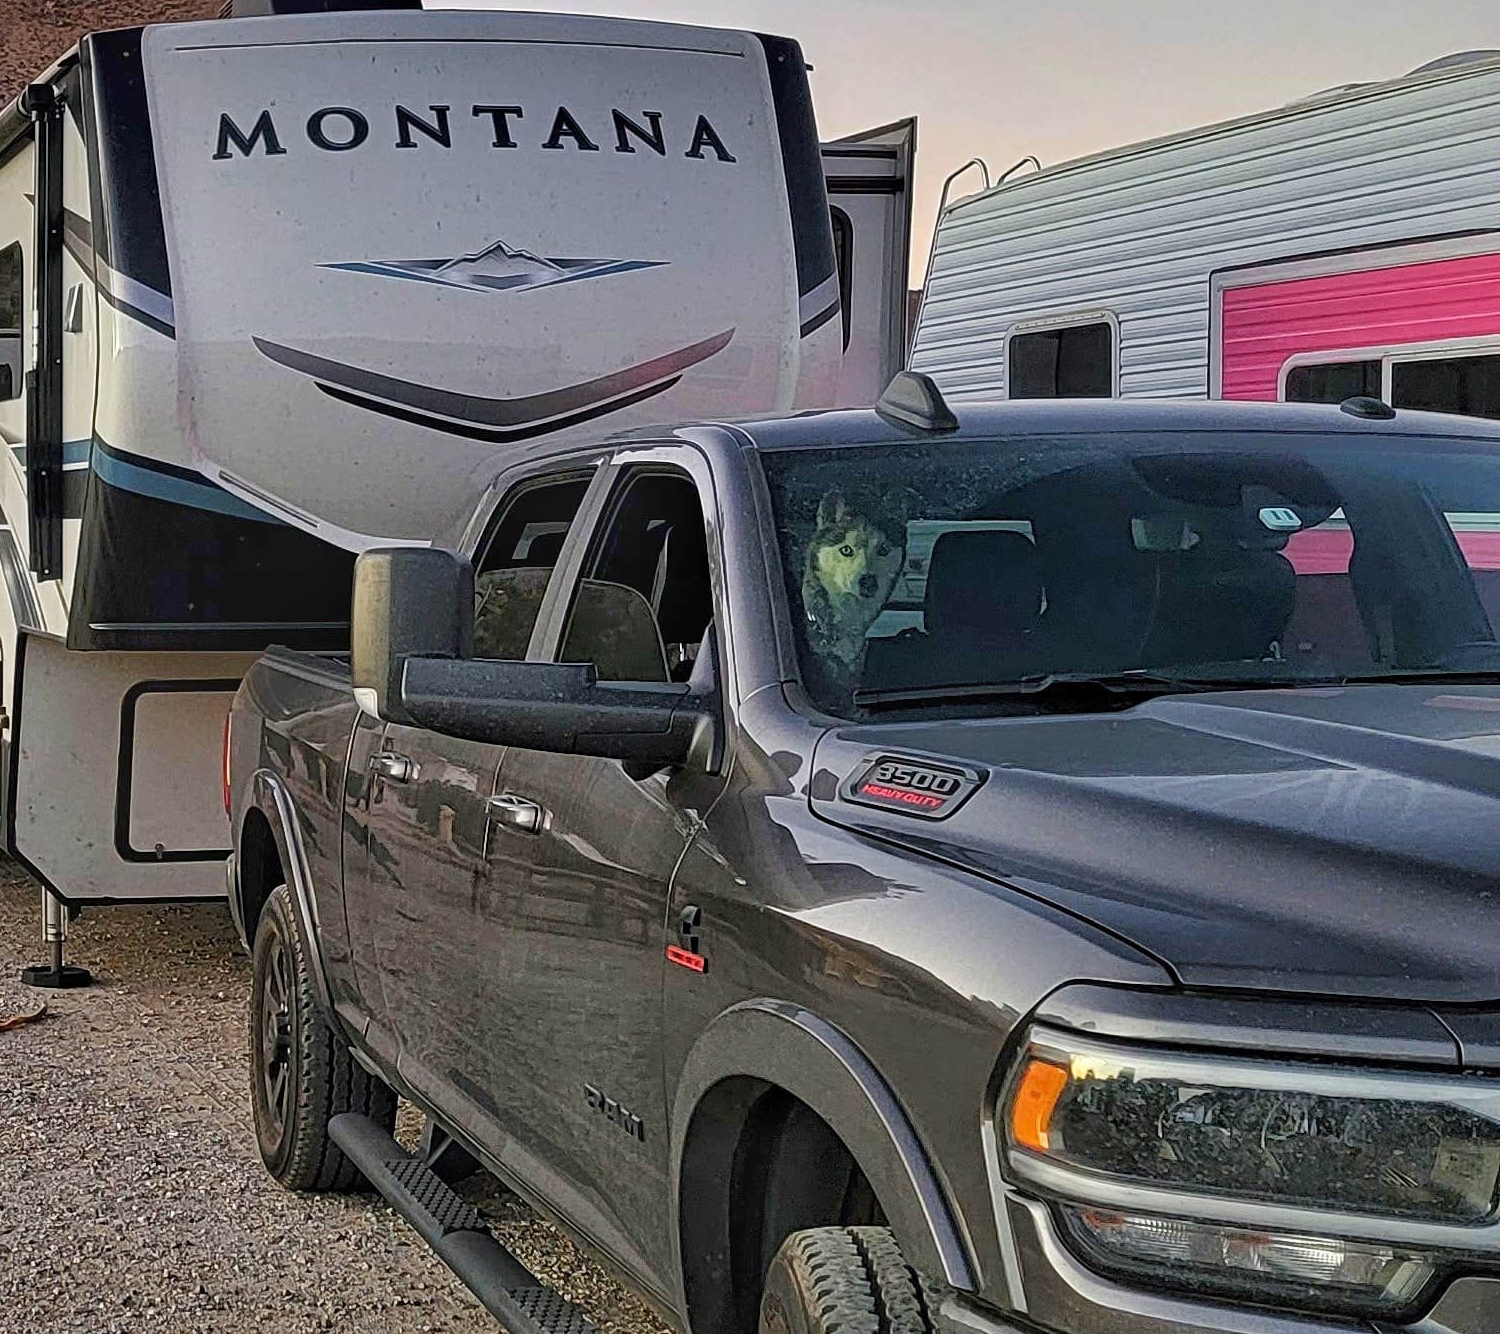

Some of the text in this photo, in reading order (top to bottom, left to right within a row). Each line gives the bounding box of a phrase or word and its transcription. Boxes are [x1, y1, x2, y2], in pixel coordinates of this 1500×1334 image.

[212, 105, 737, 164] MONTANA
[876, 763, 957, 794] 3500
[861, 784, 943, 808] HEAVY DUTY
